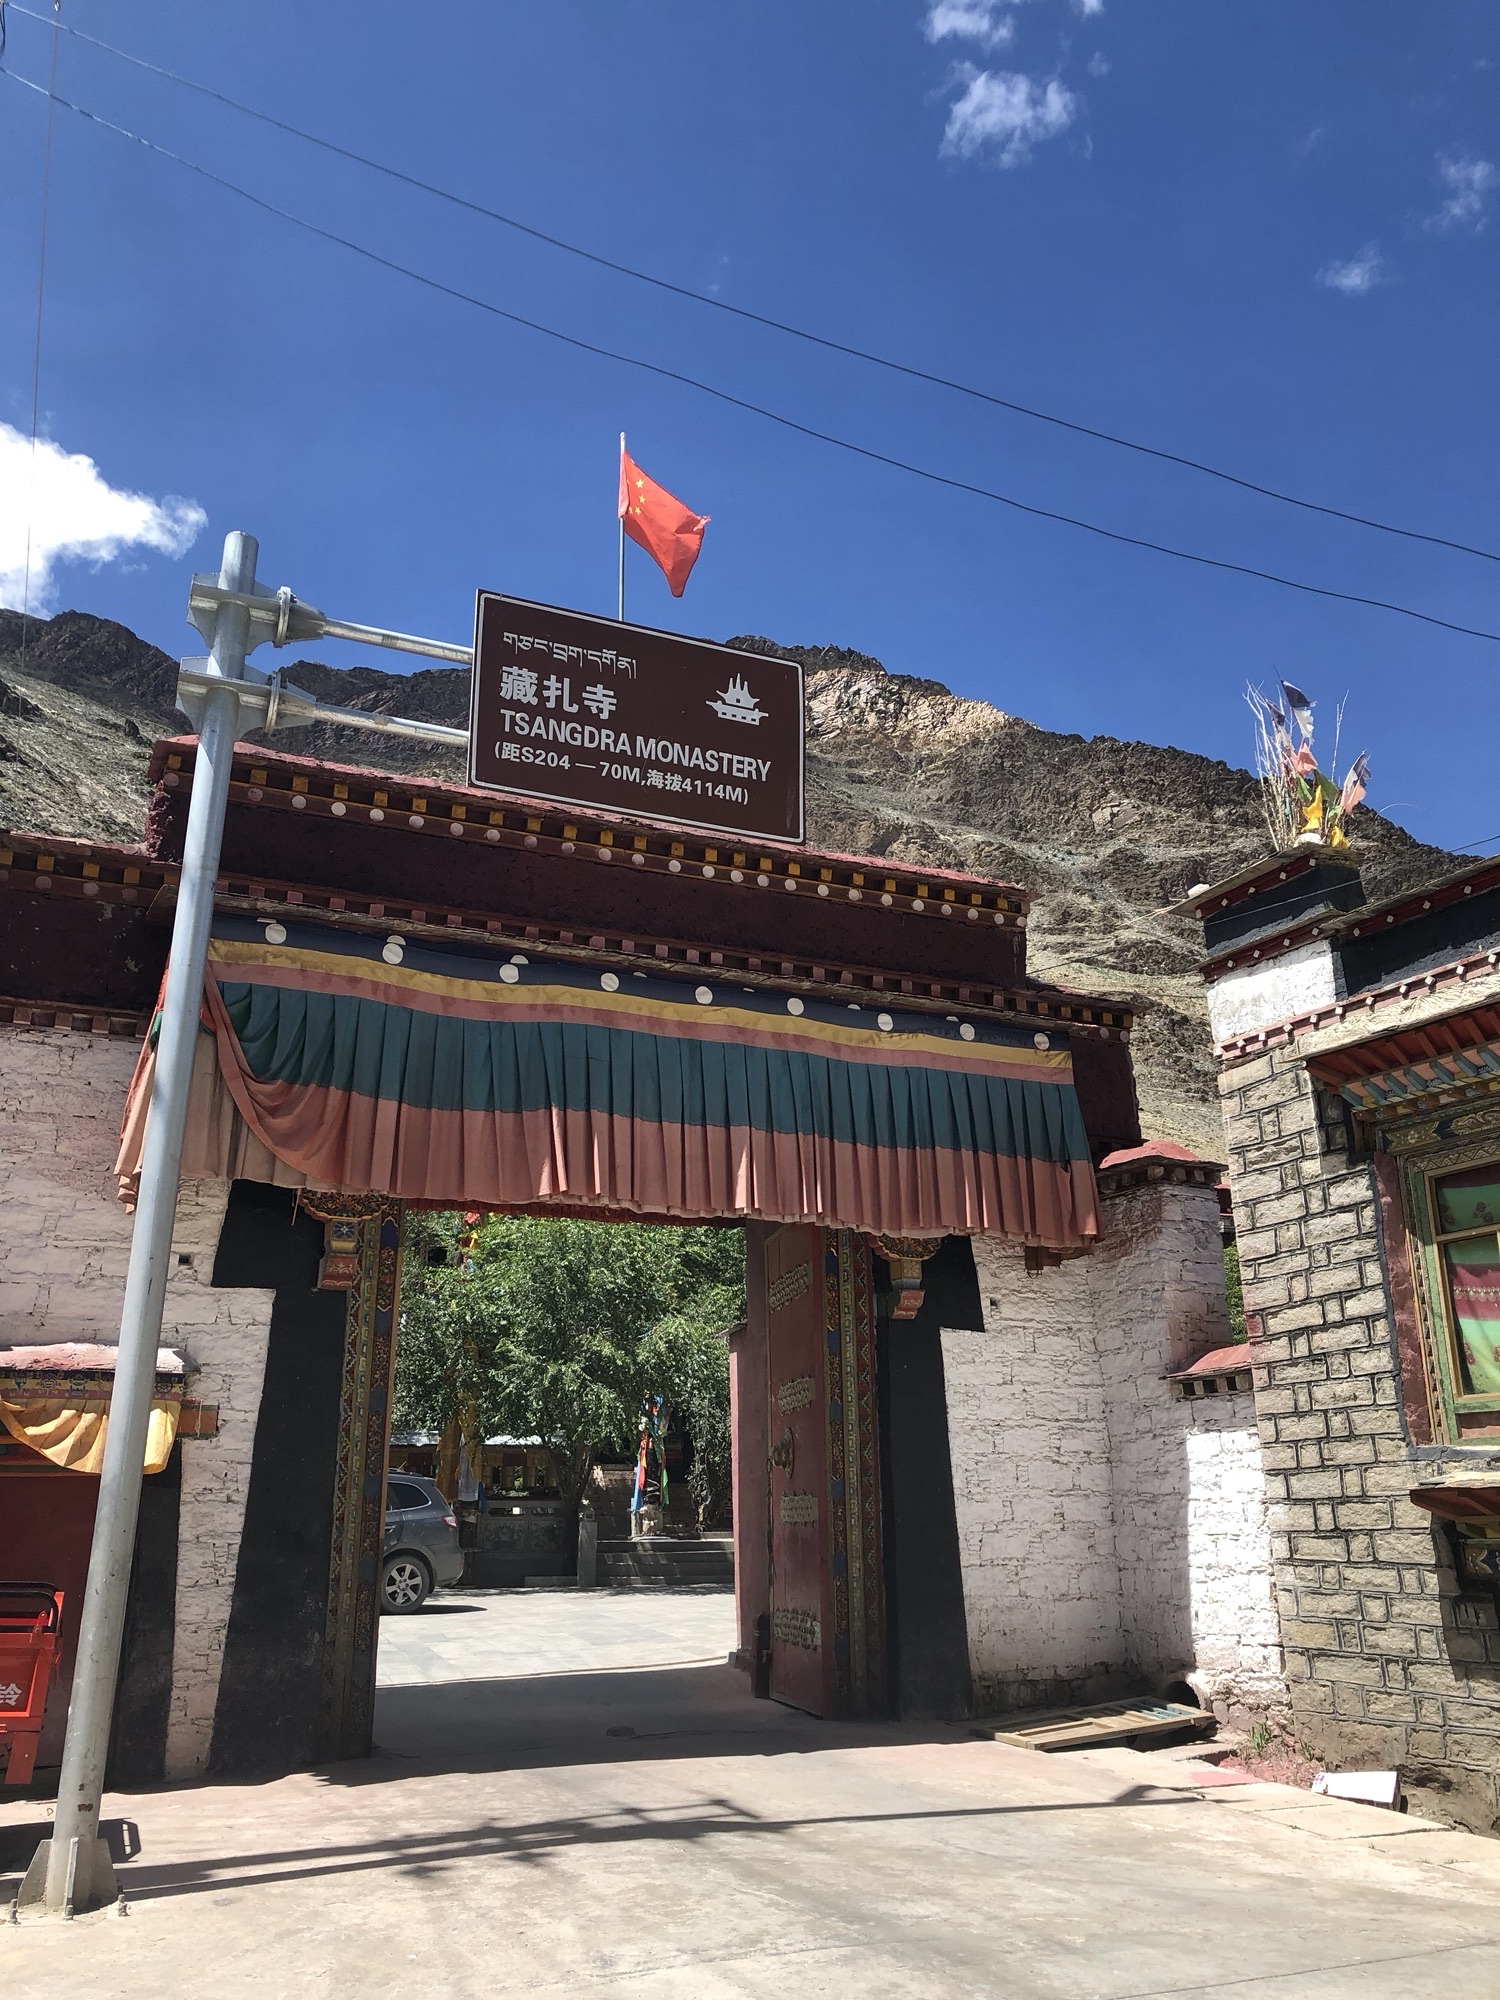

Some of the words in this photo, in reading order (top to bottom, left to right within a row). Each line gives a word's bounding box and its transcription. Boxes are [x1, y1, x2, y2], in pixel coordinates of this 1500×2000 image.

[500, 666, 616, 719] 藏扎寺
[500, 709, 632, 756] TSANGDRA
[636, 735, 771, 782] MONASTERY
